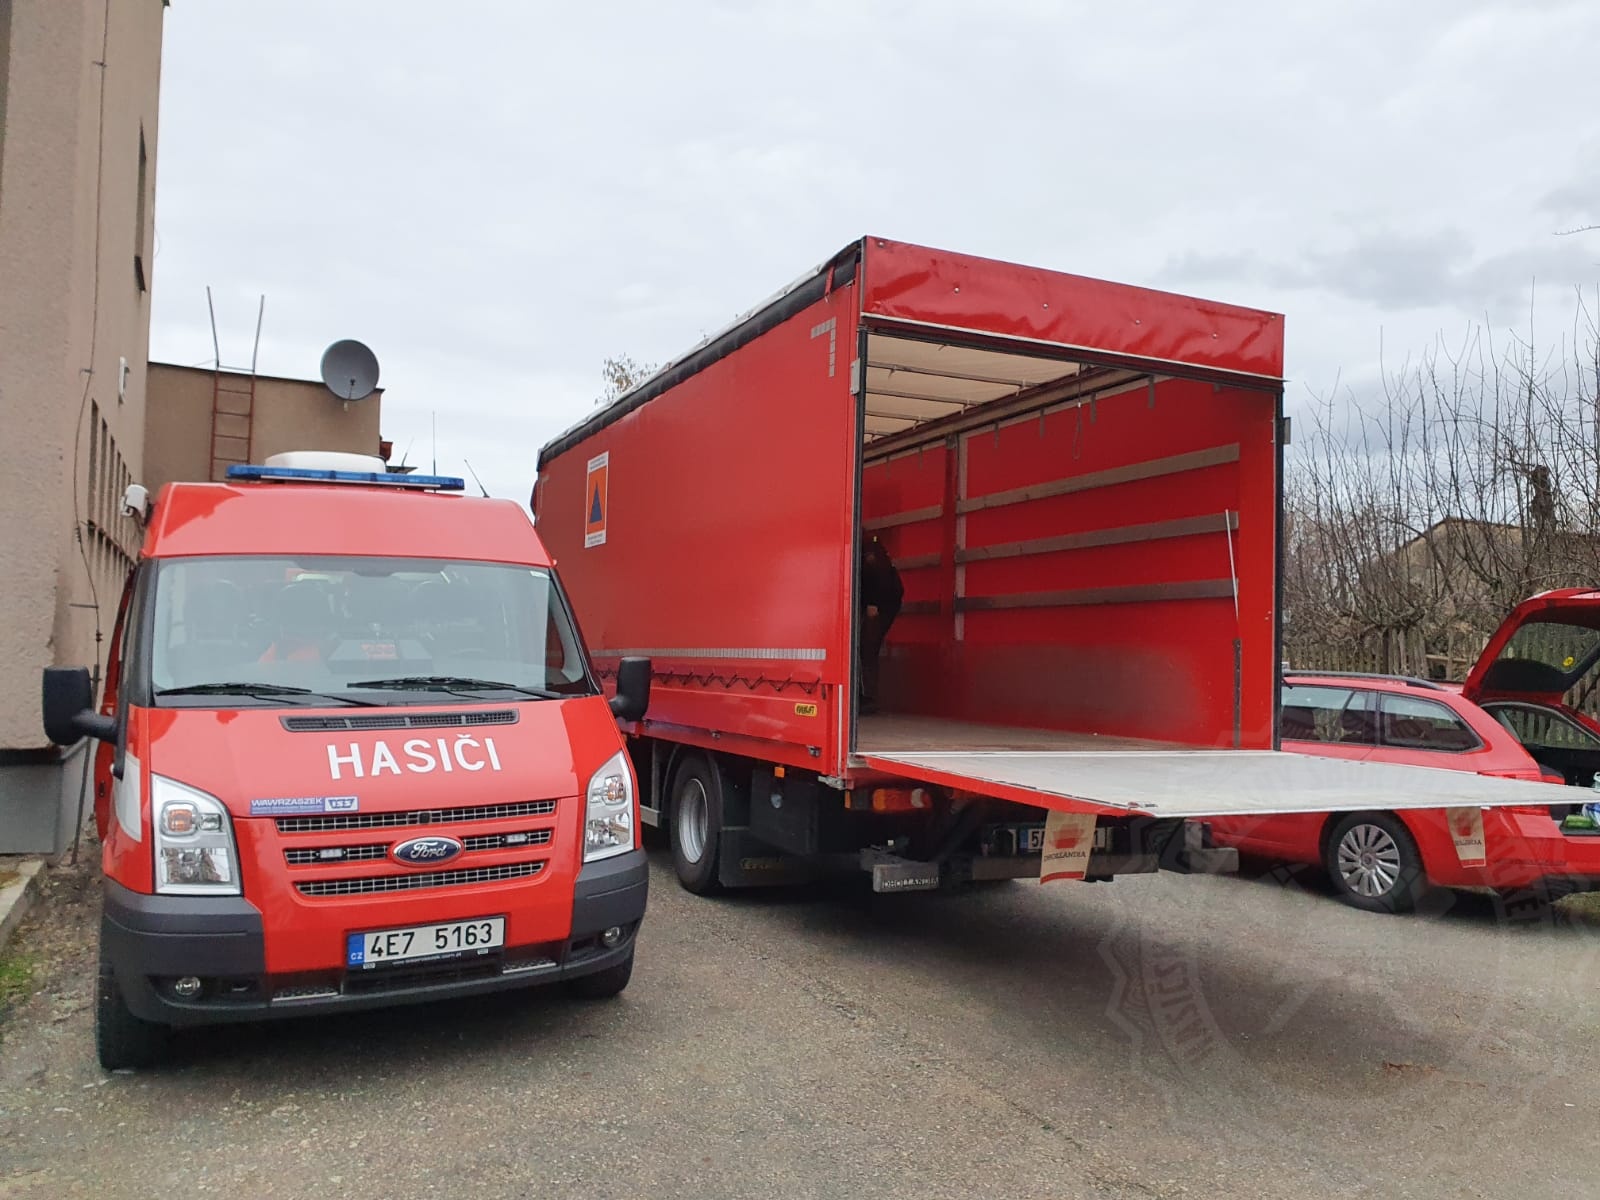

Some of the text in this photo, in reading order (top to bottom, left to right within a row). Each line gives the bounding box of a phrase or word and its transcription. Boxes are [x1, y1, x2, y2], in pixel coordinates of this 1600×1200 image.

[327, 734, 501, 780] HASIČI
[410, 841, 448, 859] Ford
[370, 923, 493, 957] 4E7 5163
[350, 952, 363, 960] CZ
